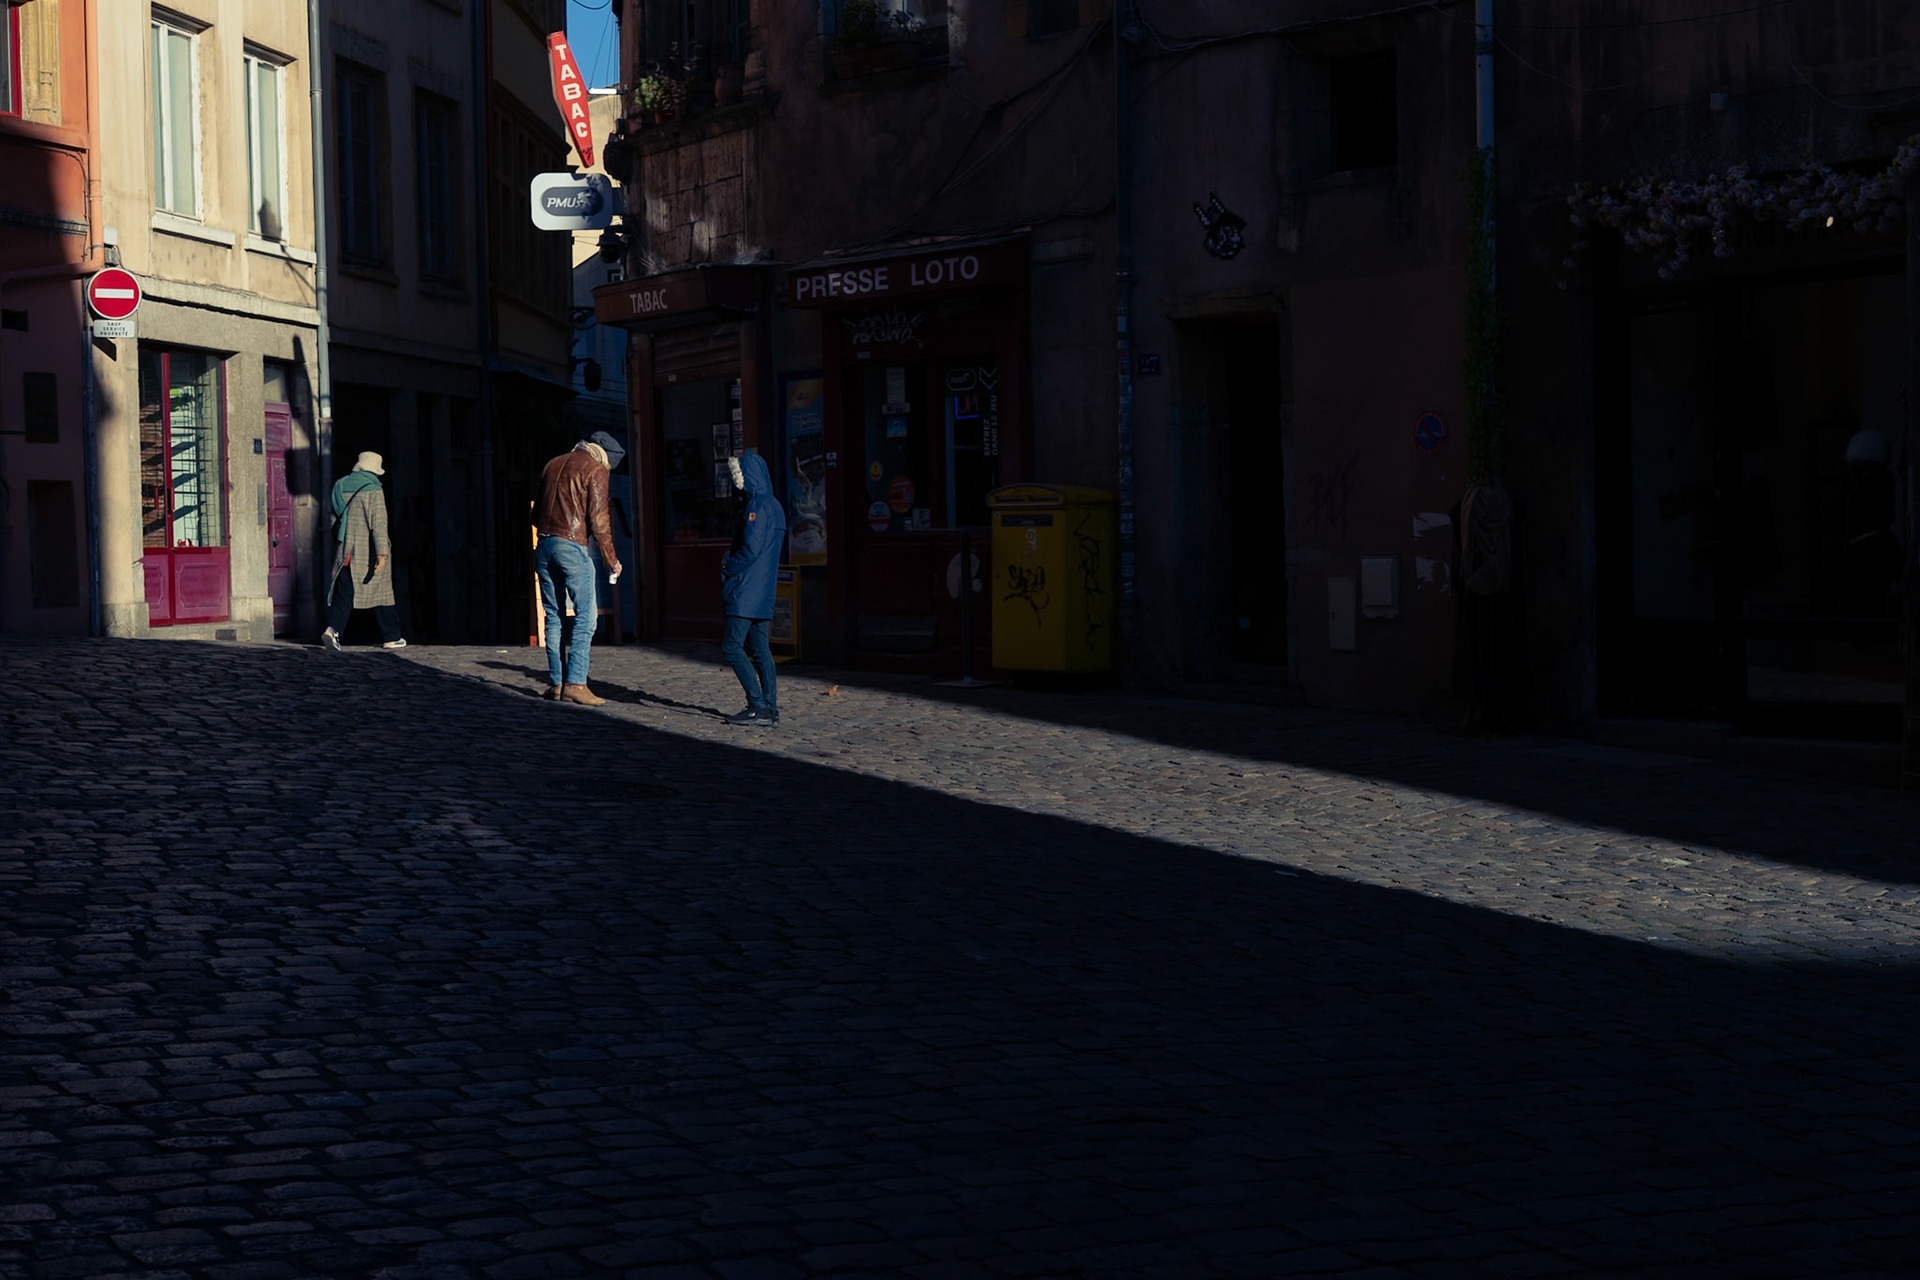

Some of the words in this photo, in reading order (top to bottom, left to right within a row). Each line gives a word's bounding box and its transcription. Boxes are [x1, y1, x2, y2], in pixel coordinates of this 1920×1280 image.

[555, 45, 589, 138] TABAC
[546, 197, 577, 209] PMU
[796, 266, 889, 300] PRESSE
[910, 254, 980, 286] LOTO
[630, 288, 669, 314] TABAC
